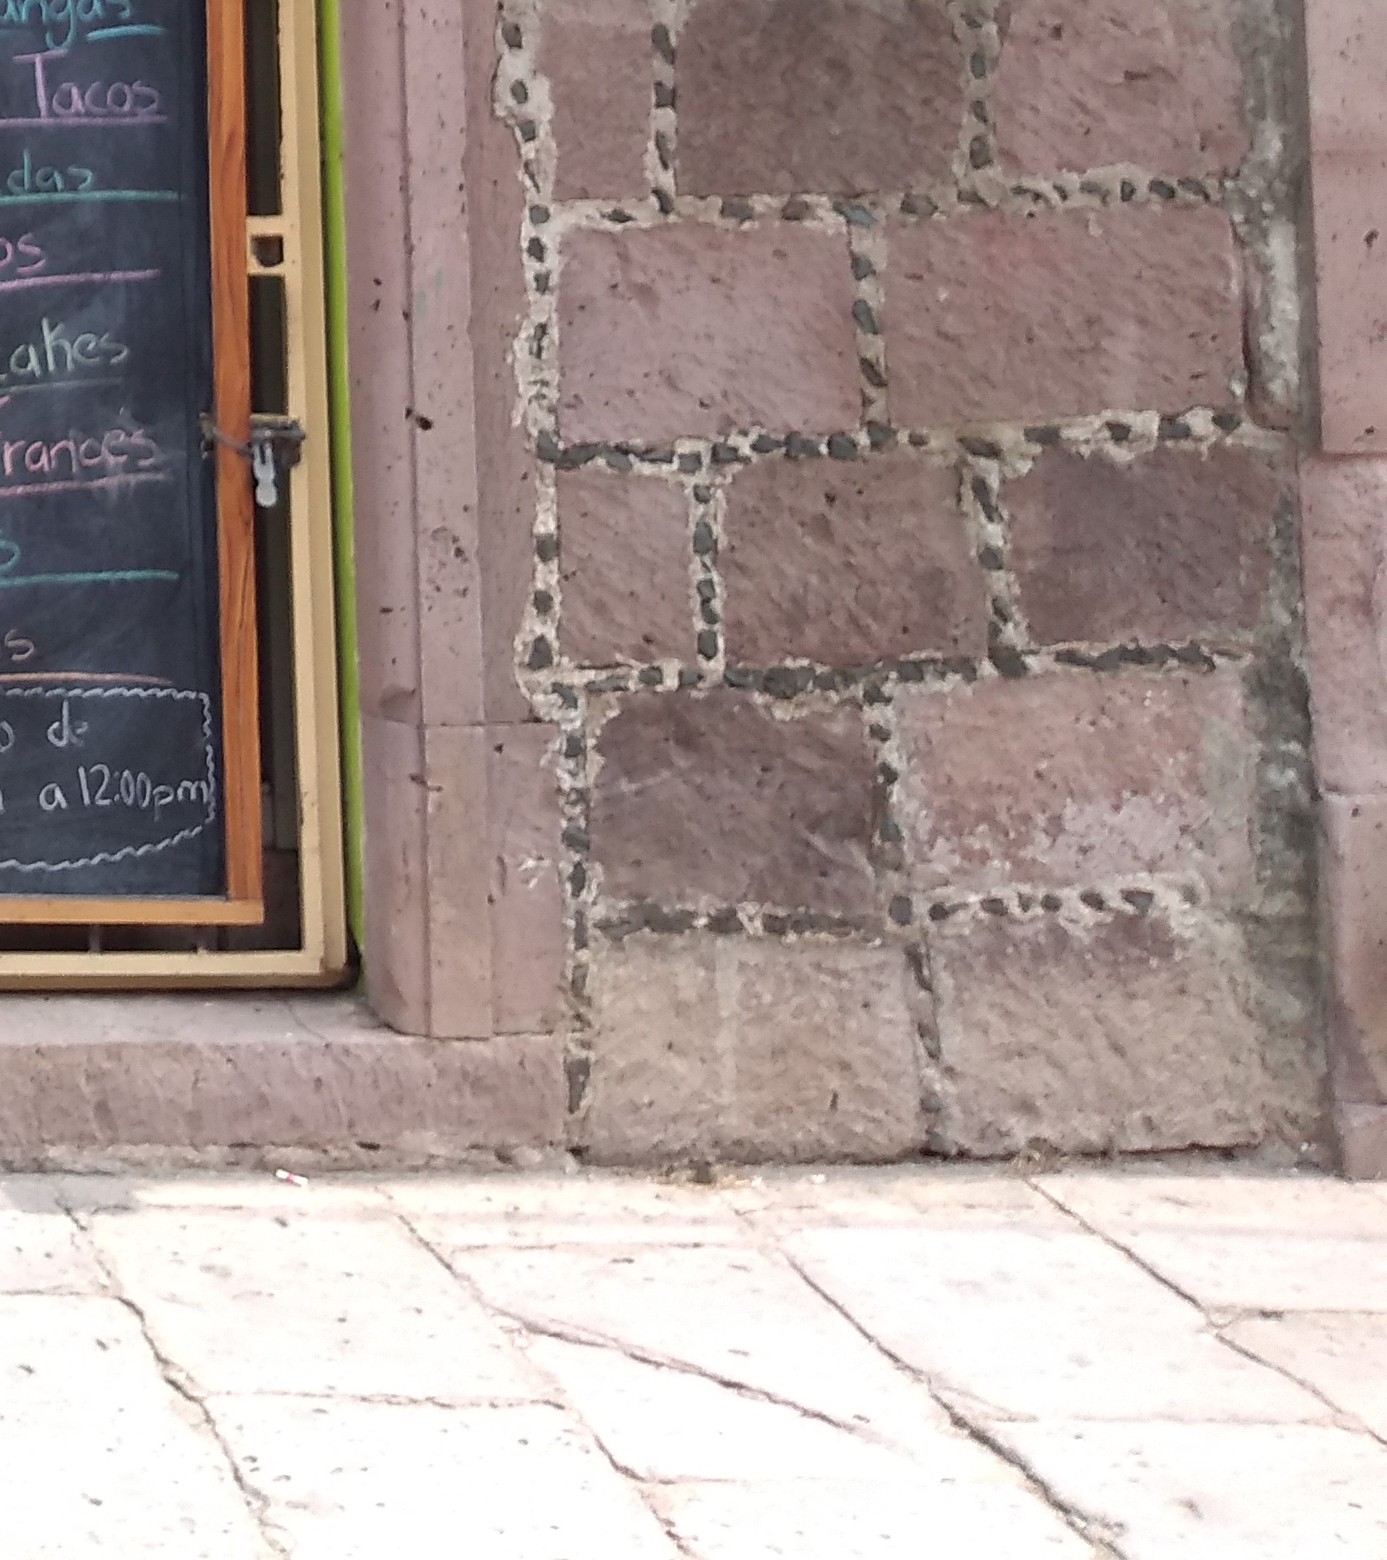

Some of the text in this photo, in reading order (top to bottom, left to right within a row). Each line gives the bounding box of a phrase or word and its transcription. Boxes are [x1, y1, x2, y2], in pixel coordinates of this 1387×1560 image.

[13, 49, 161, 119] Tacos
[47, 700, 89, 748] de
[38, 784, 68, 810] a
